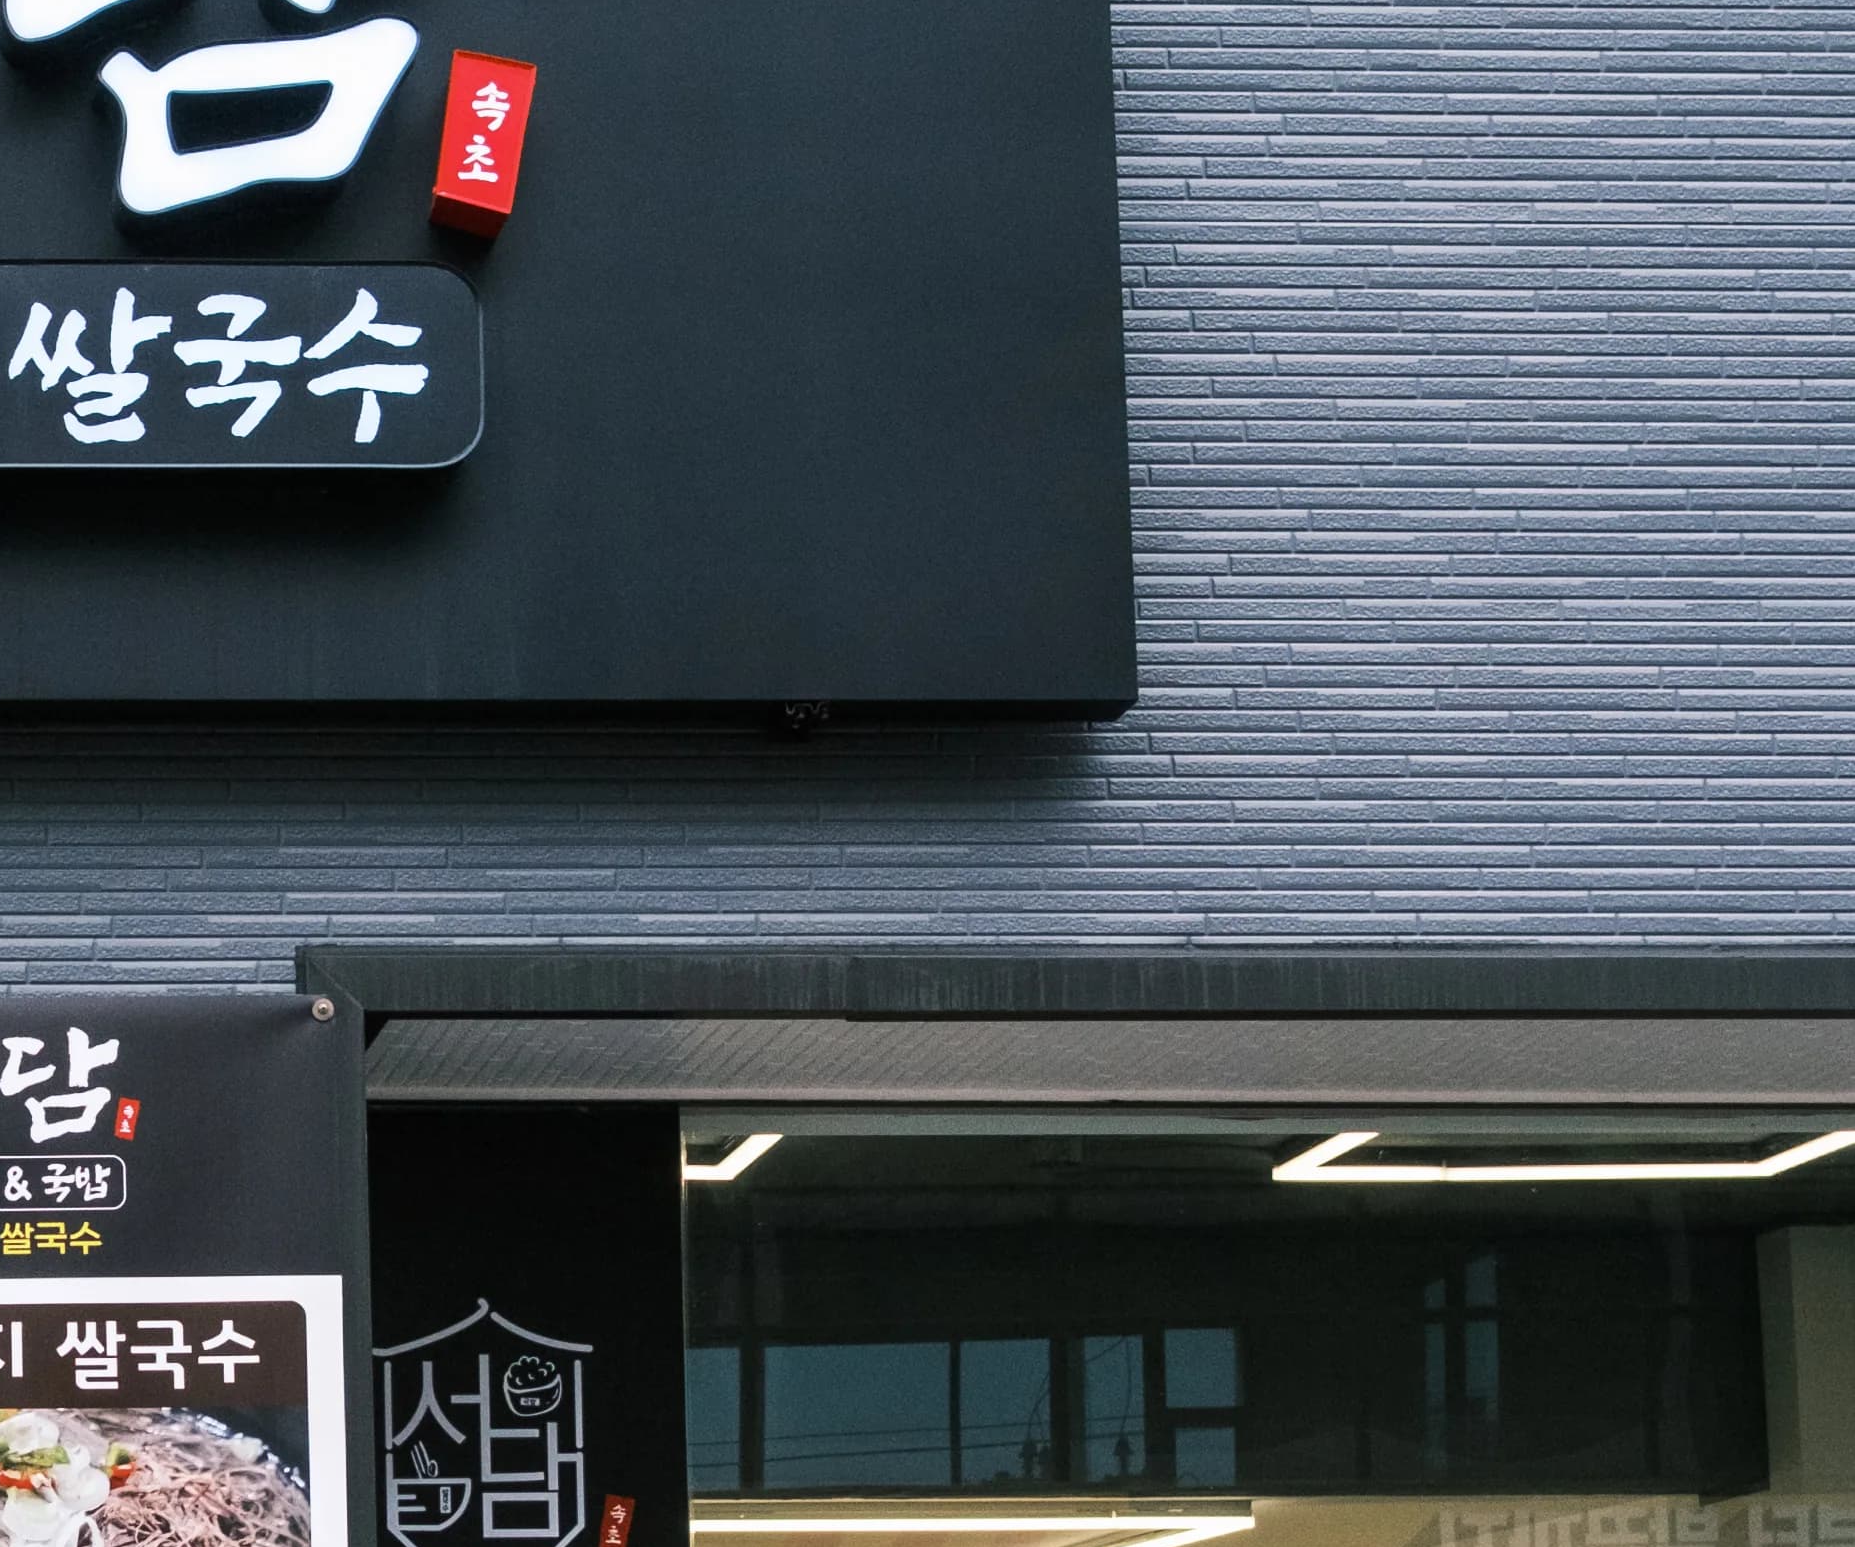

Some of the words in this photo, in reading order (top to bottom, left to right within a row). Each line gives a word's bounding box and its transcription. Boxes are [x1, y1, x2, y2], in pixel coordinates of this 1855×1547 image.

[455, 80, 512, 185] 속초
[7, 287, 429, 444] 쌀국수
[4, 1167, 33, 1204] &
[41, 1164, 113, 1204] 국밥
[0, 1220, 104, 1256] 쌀국수
[55, 1319, 262, 1391] 쌀국수
